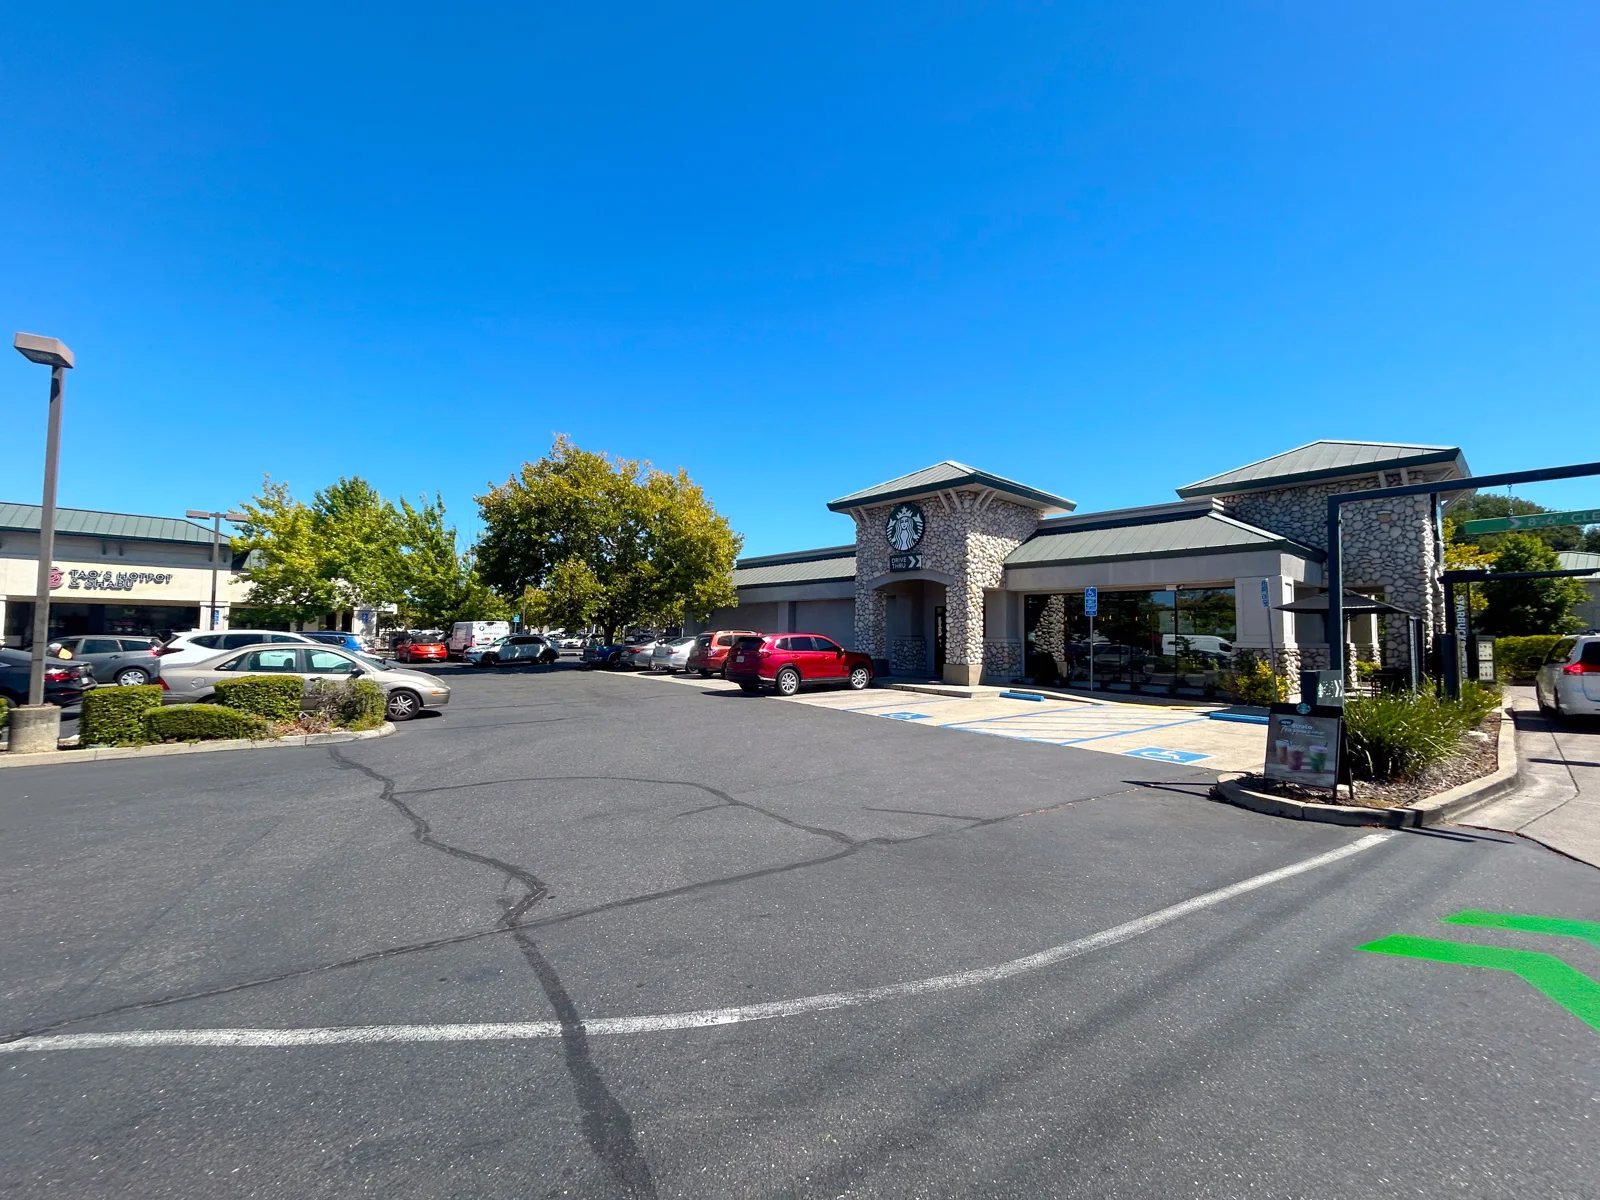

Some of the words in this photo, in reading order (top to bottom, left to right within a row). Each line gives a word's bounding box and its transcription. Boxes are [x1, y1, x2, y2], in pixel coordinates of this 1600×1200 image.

[891, 556, 907, 564] DRIVE
[69, 569, 113, 581] TAO'S
[117, 572, 174, 584] HOTPOT
[68, 578, 80, 590] &
[84, 579, 135, 591] SHABU
